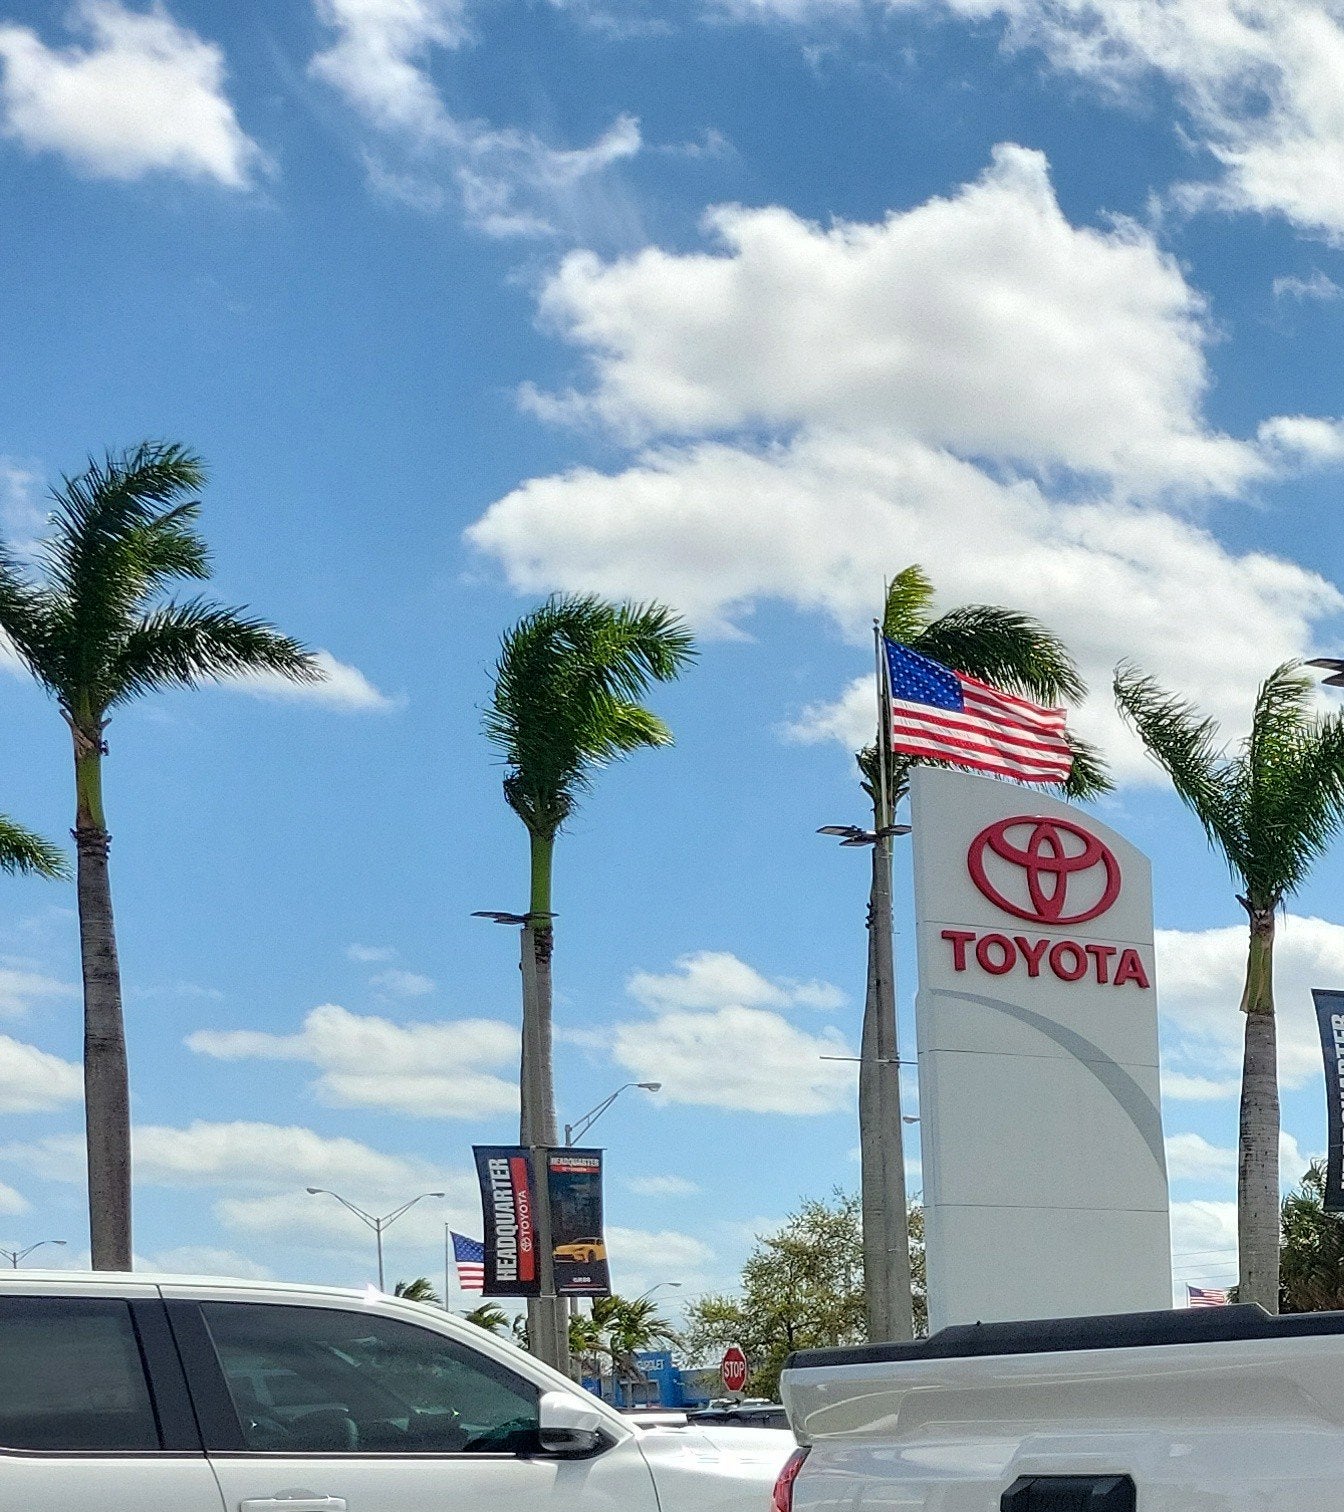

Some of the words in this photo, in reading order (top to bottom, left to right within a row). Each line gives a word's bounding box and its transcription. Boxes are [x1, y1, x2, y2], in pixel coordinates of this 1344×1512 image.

[941, 930, 1150, 989] TOYOTA
[488, 1158, 517, 1281] HEADQUARTER
[518, 1190, 531, 1237] TOYOTA
[724, 1361, 744, 1378] STOP
